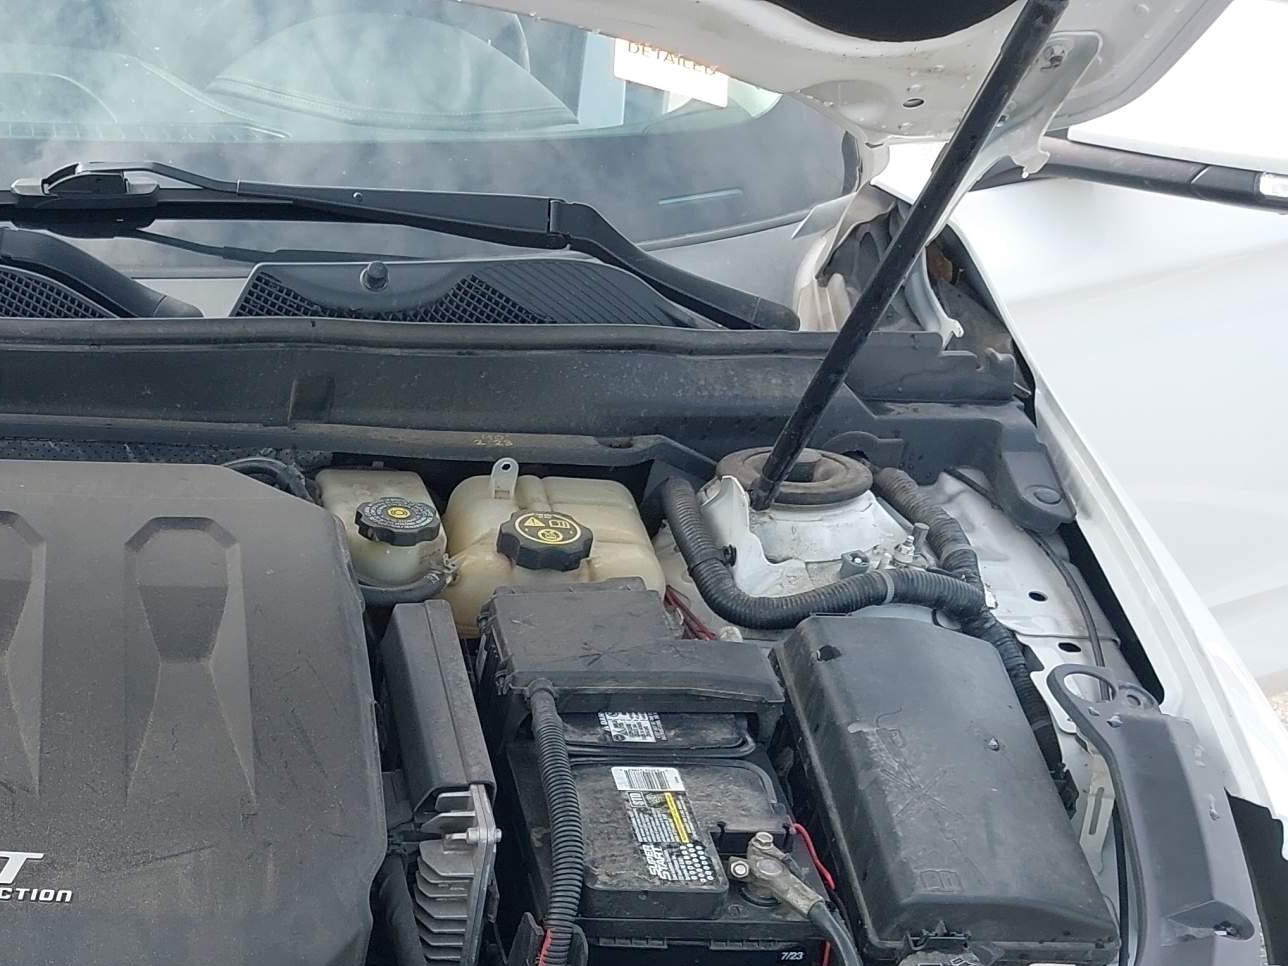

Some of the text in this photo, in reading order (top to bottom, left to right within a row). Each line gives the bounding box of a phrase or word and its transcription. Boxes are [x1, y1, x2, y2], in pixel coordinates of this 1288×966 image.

[642, 844, 657, 876] SUPER
[650, 844, 672, 881] START
[781, 951, 804, 961] 7/23
